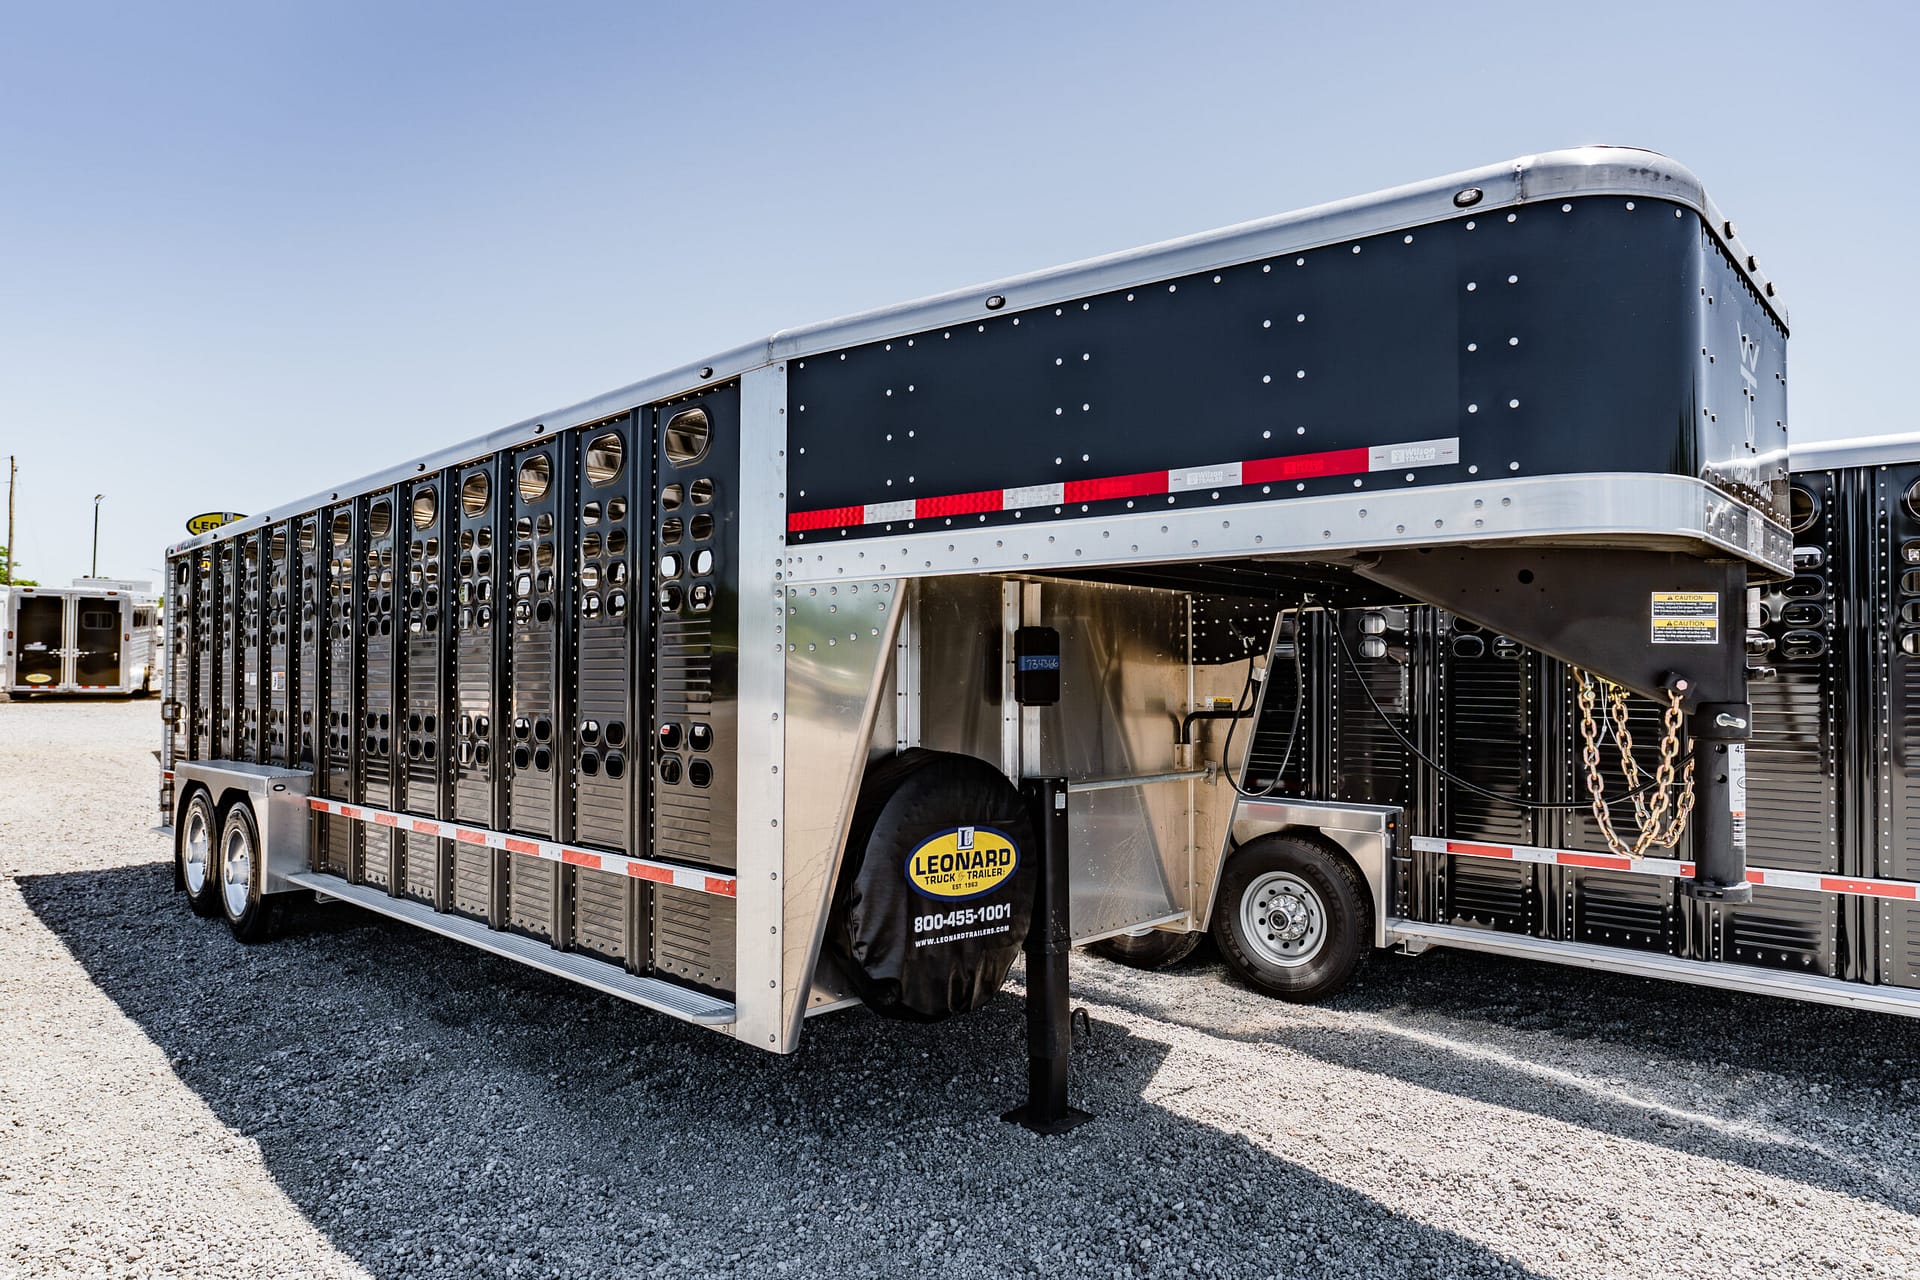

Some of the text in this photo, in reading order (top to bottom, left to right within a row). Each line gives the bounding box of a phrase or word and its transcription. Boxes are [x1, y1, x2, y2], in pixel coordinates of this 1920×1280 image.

[915, 848, 1011, 876] LEONARD
[924, 873, 956, 885] TRUCK
[967, 867, 1003, 880] TRAILER
[914, 903, 1011, 933] 800-455-1001
[915, 925, 1010, 948] WWW.LEONARDTRAILERS.COM
